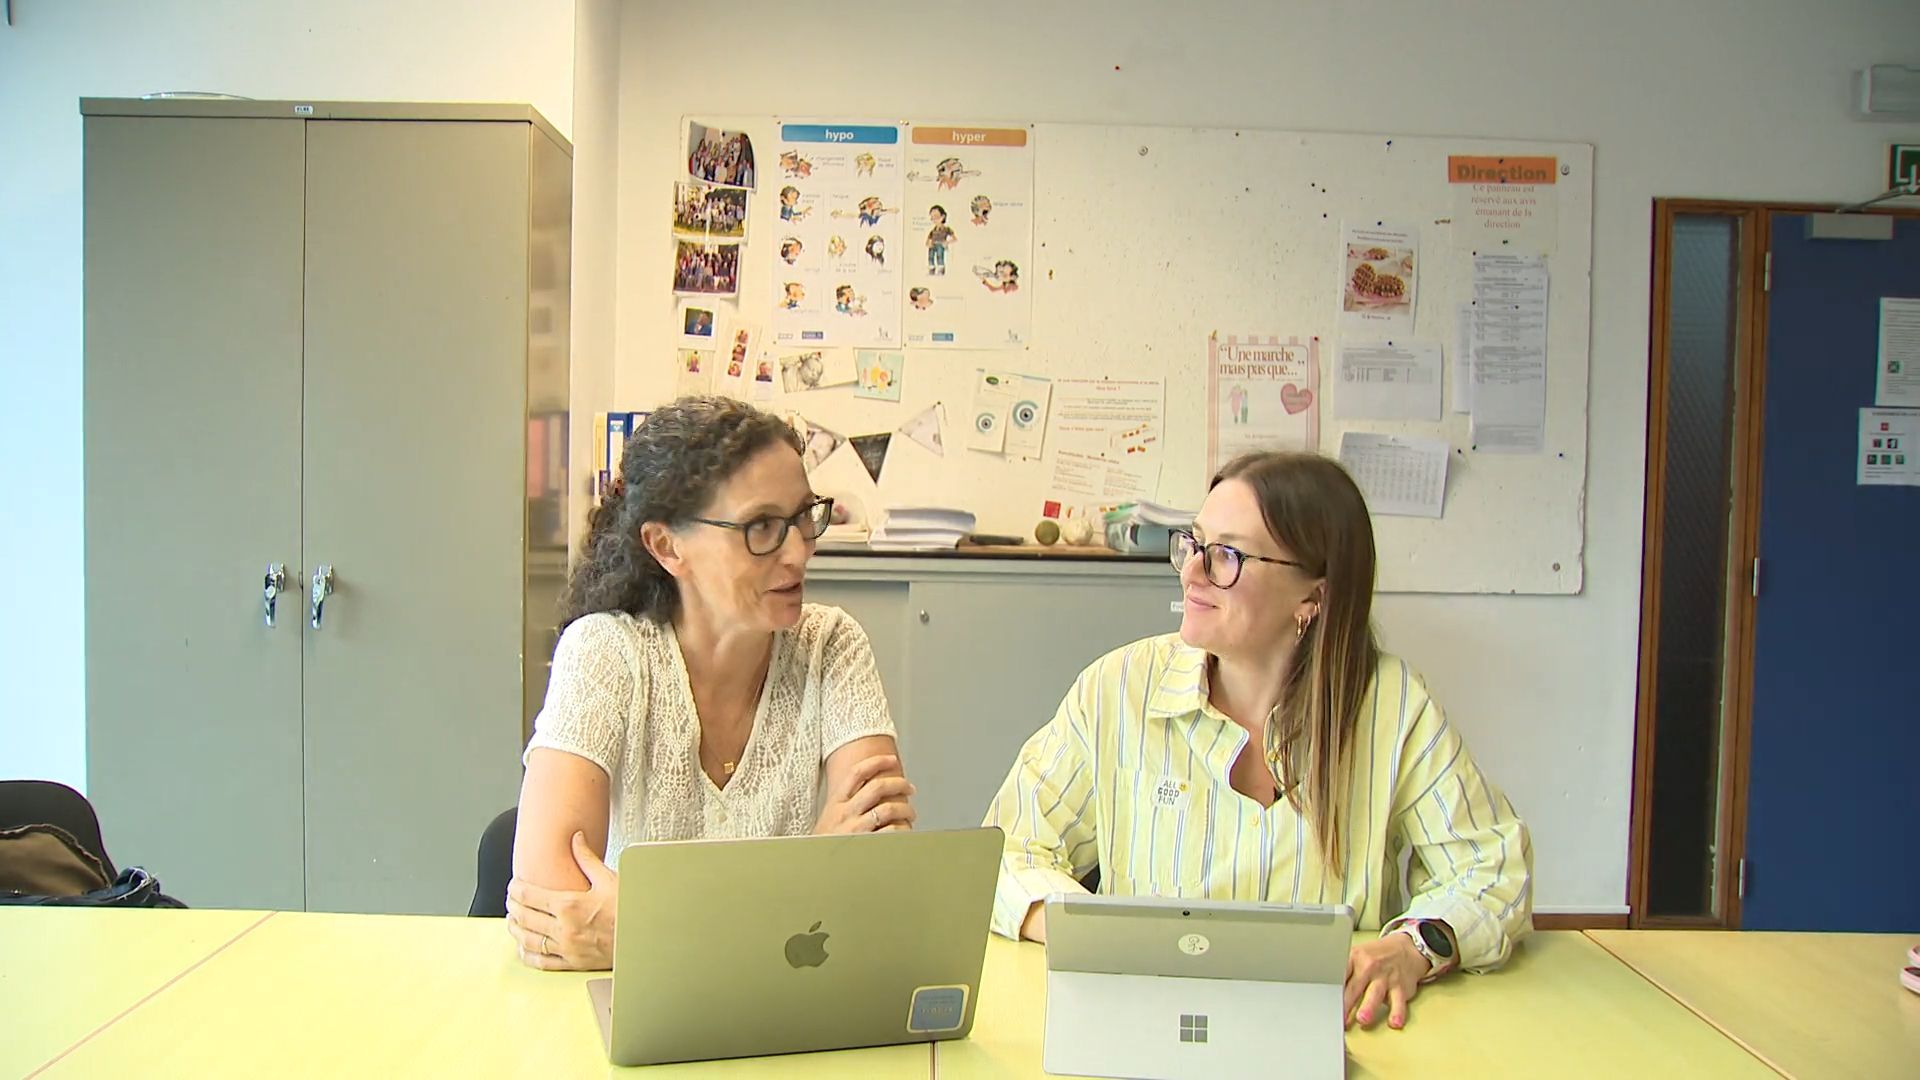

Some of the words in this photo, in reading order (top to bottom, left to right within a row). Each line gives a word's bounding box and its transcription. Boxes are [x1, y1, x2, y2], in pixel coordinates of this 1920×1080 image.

[825, 129, 854, 142] hypo
[952, 130, 986, 144] hyper
[1457, 164, 1547, 180] Direction
[1473, 184, 1485, 193] Ce
[1486, 186, 1521, 194] panneau
[1522, 185, 1535, 193] est
[1502, 197, 1518, 205] aux
[1519, 196, 1537, 205] avis
[1475, 207, 1510, 217] émanant
[1511, 208, 1523, 217] de
[1524, 208, 1532, 217] la
[1484, 219, 1521, 229] direction
[1253, 347, 1294, 362] marche
[1219, 363, 1246, 375] mais
[1247, 364, 1266, 379] pas
[1163, 780, 1176, 789] ALL
[1157, 786, 1180, 798] GOOD
[1158, 795, 1176, 805] FUN
